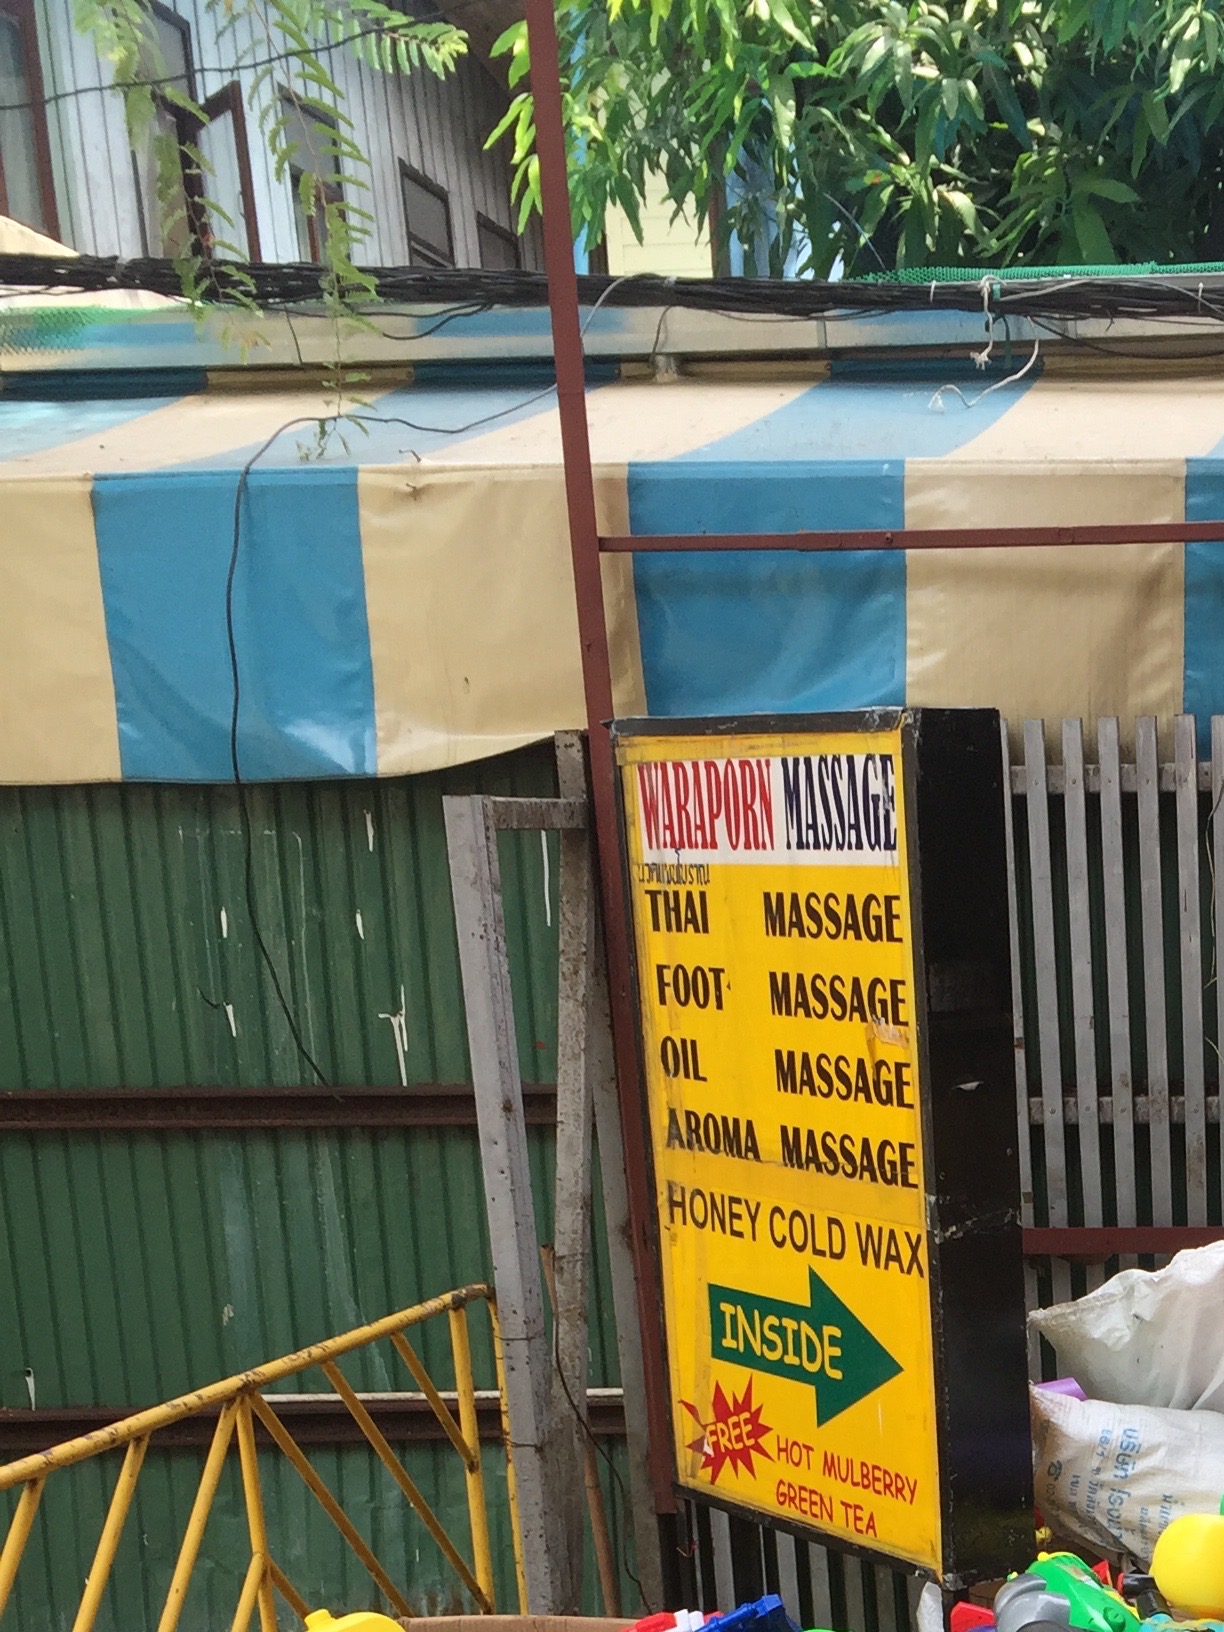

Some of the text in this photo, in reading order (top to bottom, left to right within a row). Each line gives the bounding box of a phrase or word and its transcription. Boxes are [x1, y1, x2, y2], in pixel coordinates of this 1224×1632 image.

[638, 754, 897, 850] WARAPORN MASSAGE
[645, 889, 903, 943] THAI MASSAGE
[656, 964, 909, 1026] FOOT MASSAGE
[660, 1036, 914, 1109] OIL MASSAGE
[666, 1108, 919, 1189] AROMA MASSAGE
[667, 1180, 925, 1279] HONEY COLD WAX
[720, 1302, 843, 1380] INSIDE
[705, 1416, 755, 1455] FREE
[777, 1434, 918, 1505] HOT MULBERRY
[776, 1479, 878, 1538] GREEN TEA
